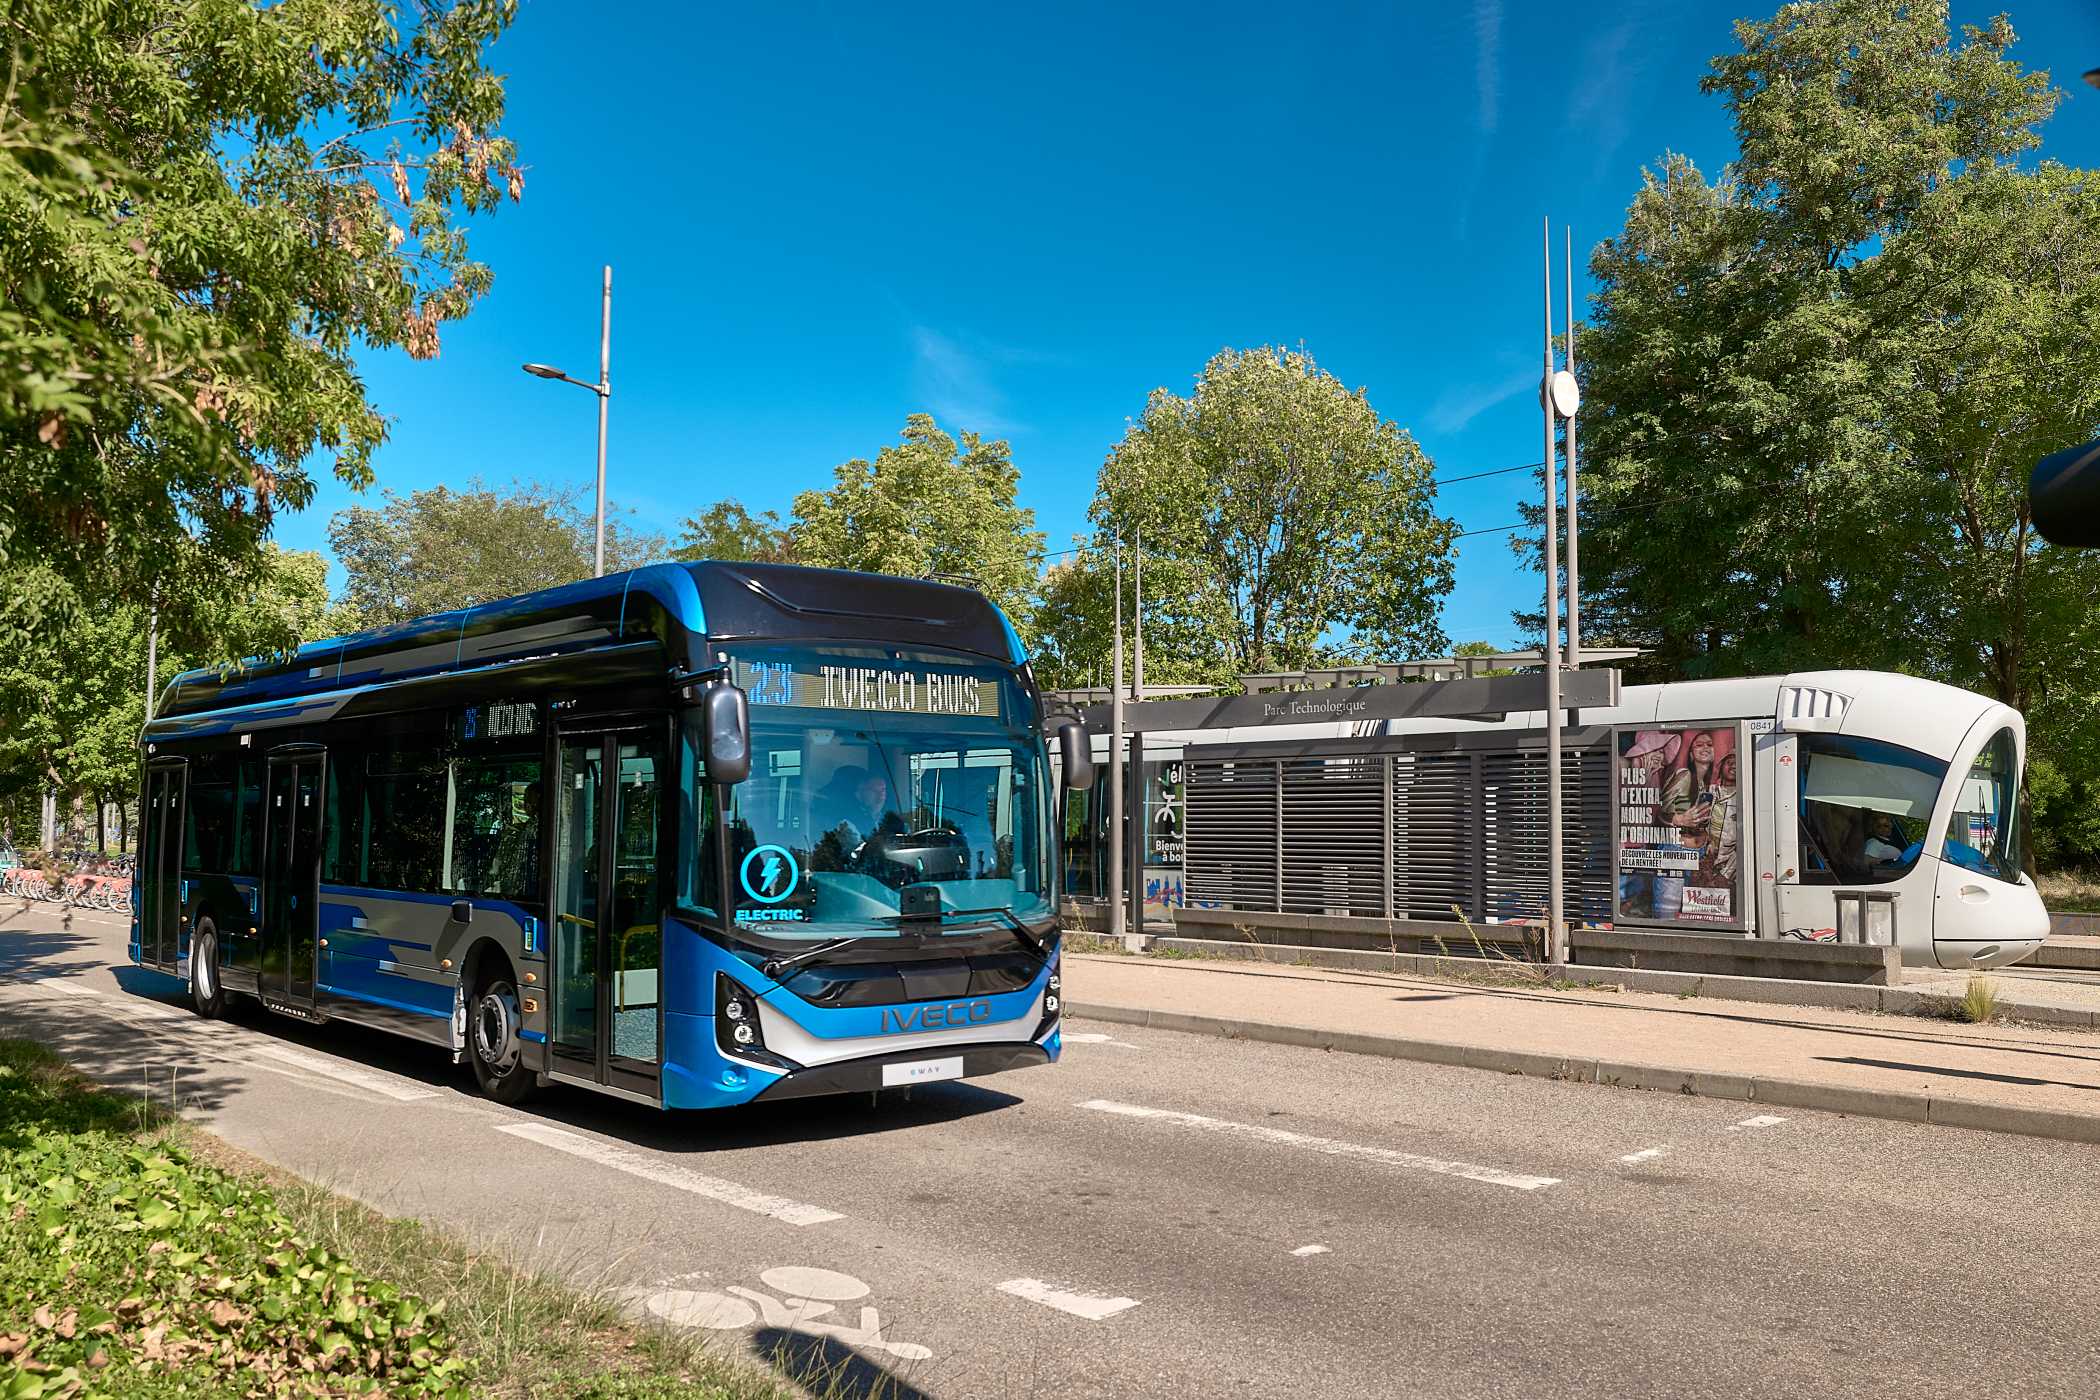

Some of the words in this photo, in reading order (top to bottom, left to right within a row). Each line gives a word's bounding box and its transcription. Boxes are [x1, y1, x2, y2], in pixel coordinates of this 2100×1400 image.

[820, 665, 916, 710] IVECO
[926, 673, 980, 714] BUS
[1263, 703, 1287, 716] Parc
[1288, 698, 1367, 716] Technologique
[1750, 722, 1772, 730] 0841
[1621, 767, 1646, 785] PLUS
[1620, 787, 1663, 806] D'EXTRA,
[1620, 806, 1653, 824] MOINS
[1620, 826, 1685, 845] D'ORDINAIRE.
[1652, 850, 1662, 859] LES
[1686, 889, 1726, 906] Westfield
[735, 908, 803, 921] ELECTRIC
[880, 998, 993, 1032] IVECO
